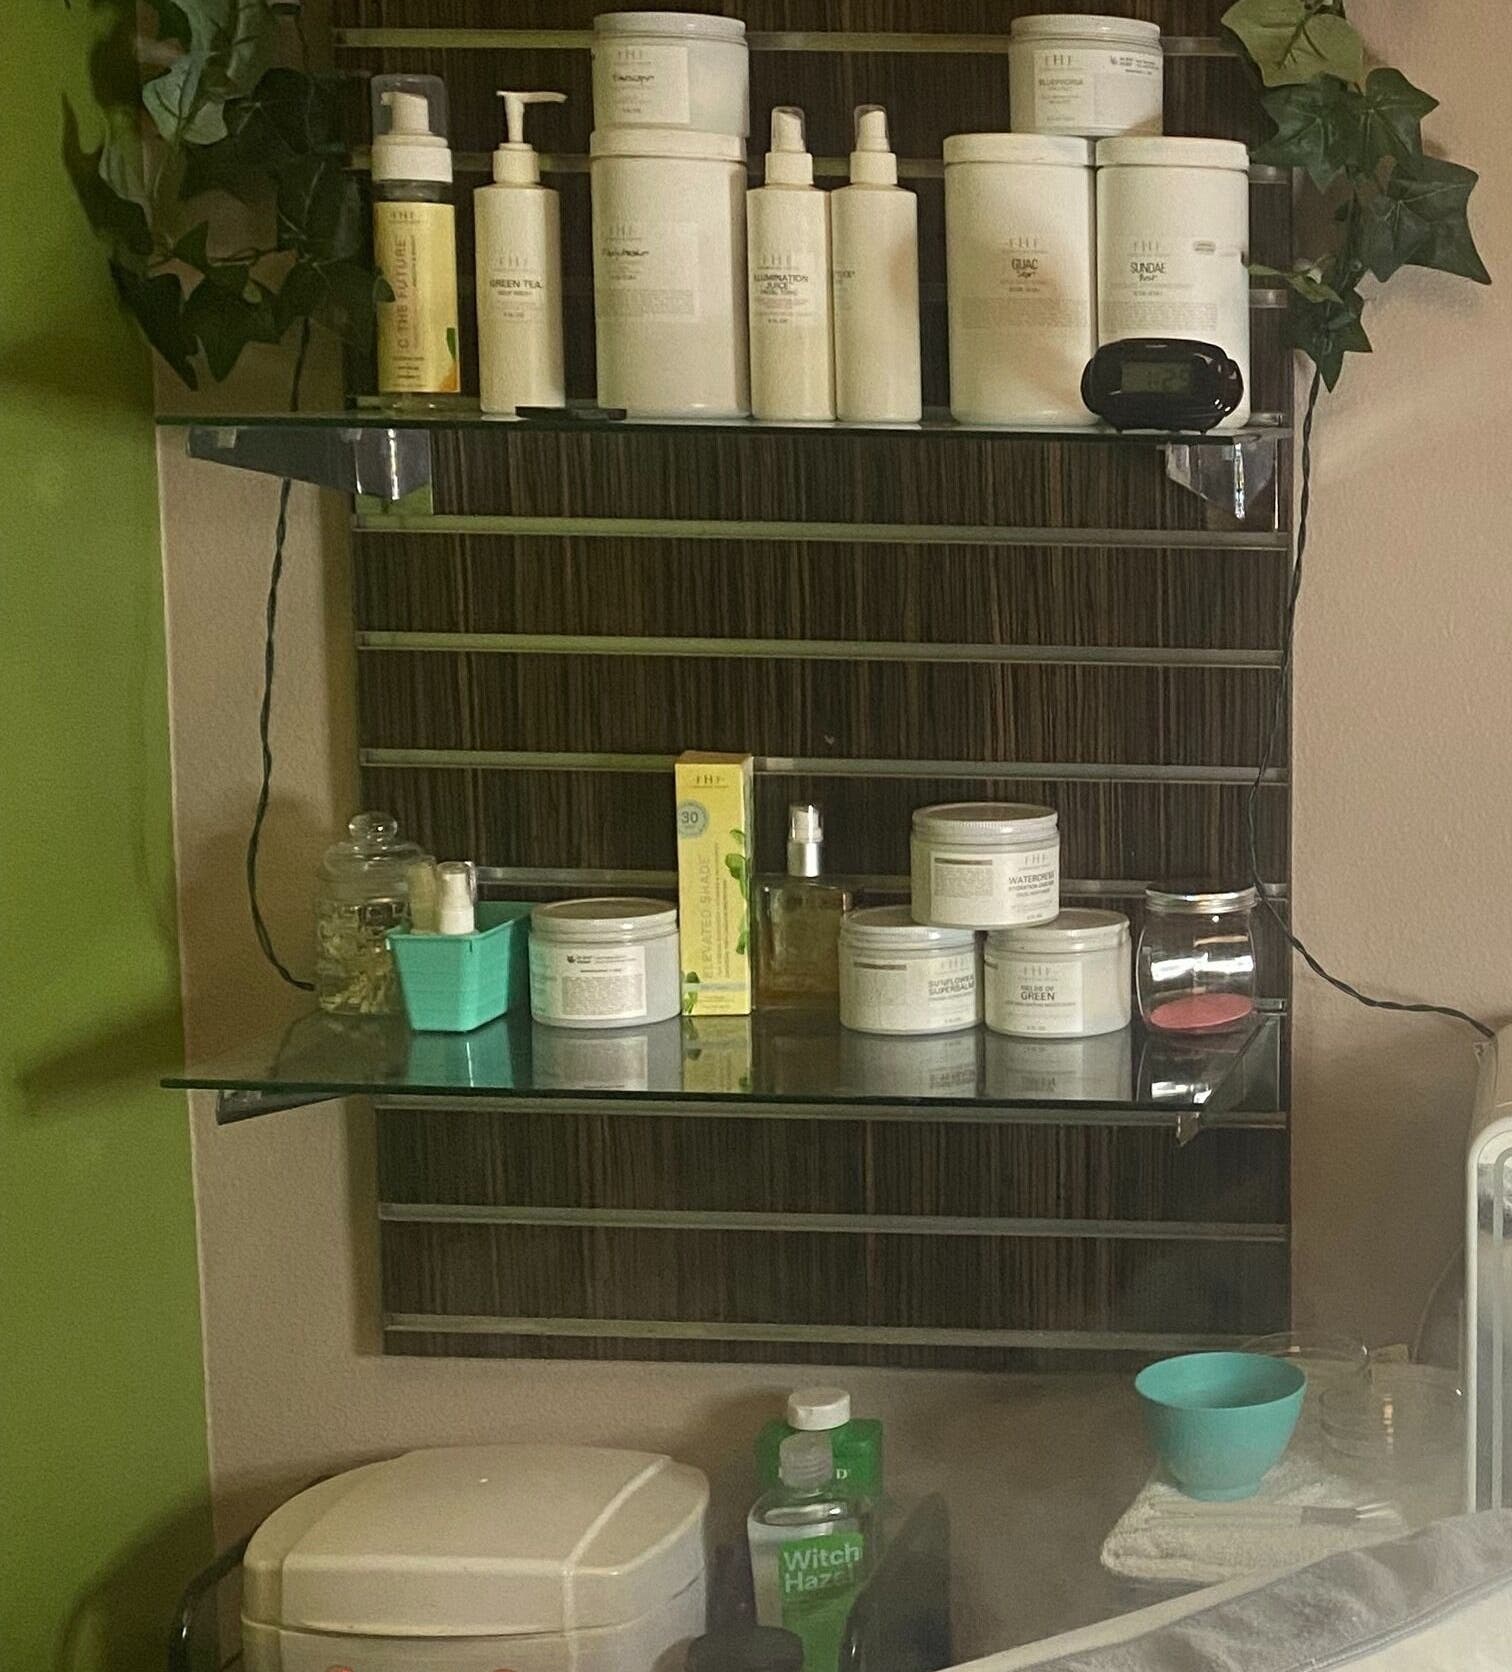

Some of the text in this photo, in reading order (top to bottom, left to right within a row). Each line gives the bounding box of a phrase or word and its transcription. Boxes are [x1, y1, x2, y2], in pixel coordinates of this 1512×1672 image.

[395, 236, 409, 299] FUTURE
[1011, 258, 1038, 270] GUAC
[1130, 262, 1166, 274] SUNDAE
[489, 279, 543, 289] GREEN TEA
[754, 274, 808, 283] ILLUMINATION
[396, 305, 409, 331] THE
[681, 811, 698, 824] 30
[698, 856, 713, 979] ELEVATED SHADE
[1021, 991, 1055, 1001] GREEN
[783, 1542, 860, 1571] Witch
